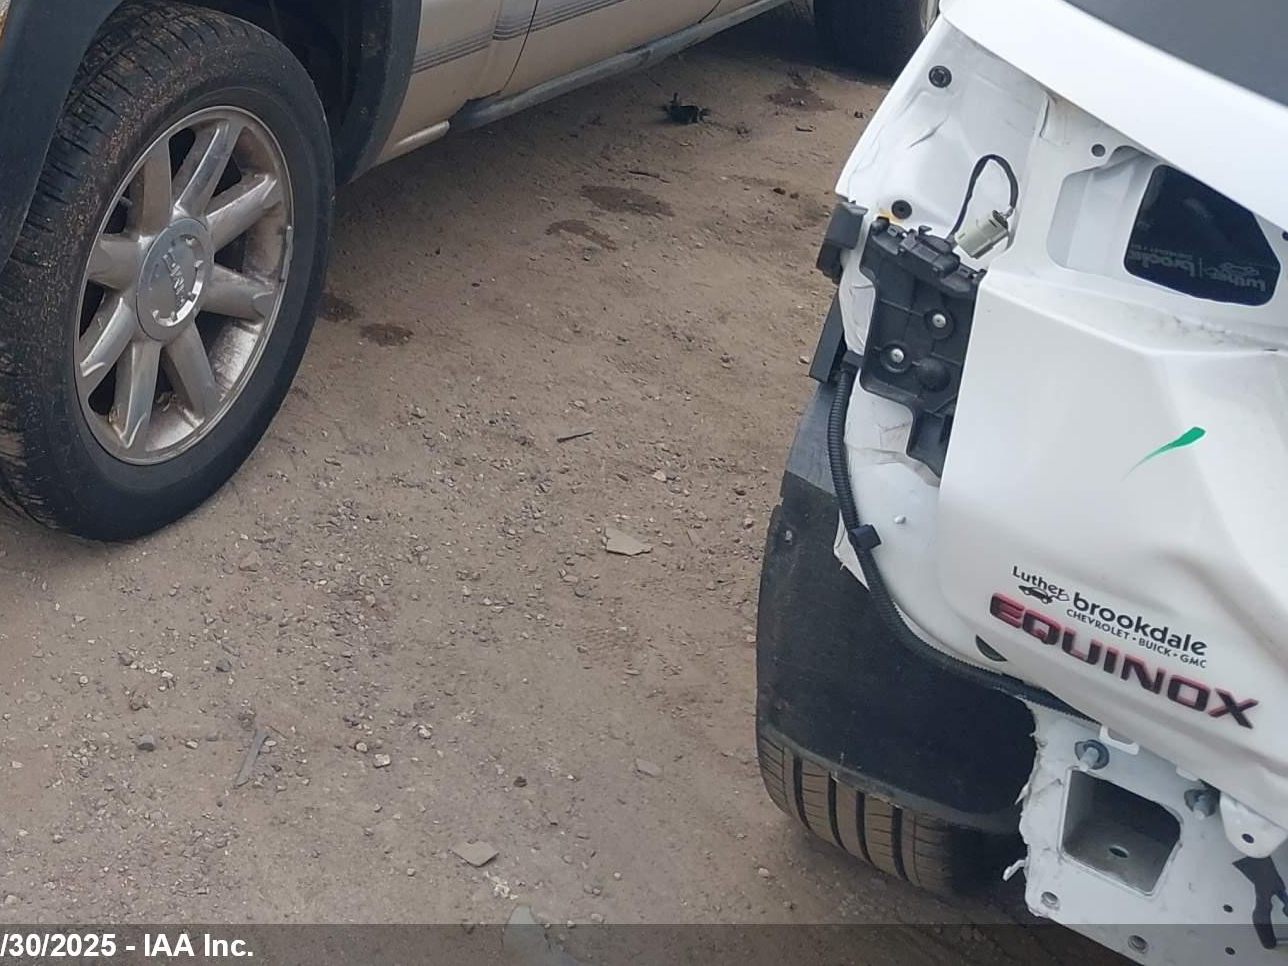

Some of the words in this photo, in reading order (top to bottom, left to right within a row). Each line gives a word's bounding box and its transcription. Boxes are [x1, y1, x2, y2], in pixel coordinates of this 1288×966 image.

[1013, 565, 1065, 595] Luther
[1066, 608, 1130, 640] CHEVROLET
[1138, 637, 1171, 657] BUICK
[1180, 653, 1208, 669] GMC
[1073, 591, 1208, 656] brookdale
[989, 592, 1259, 730] EQUINOX
